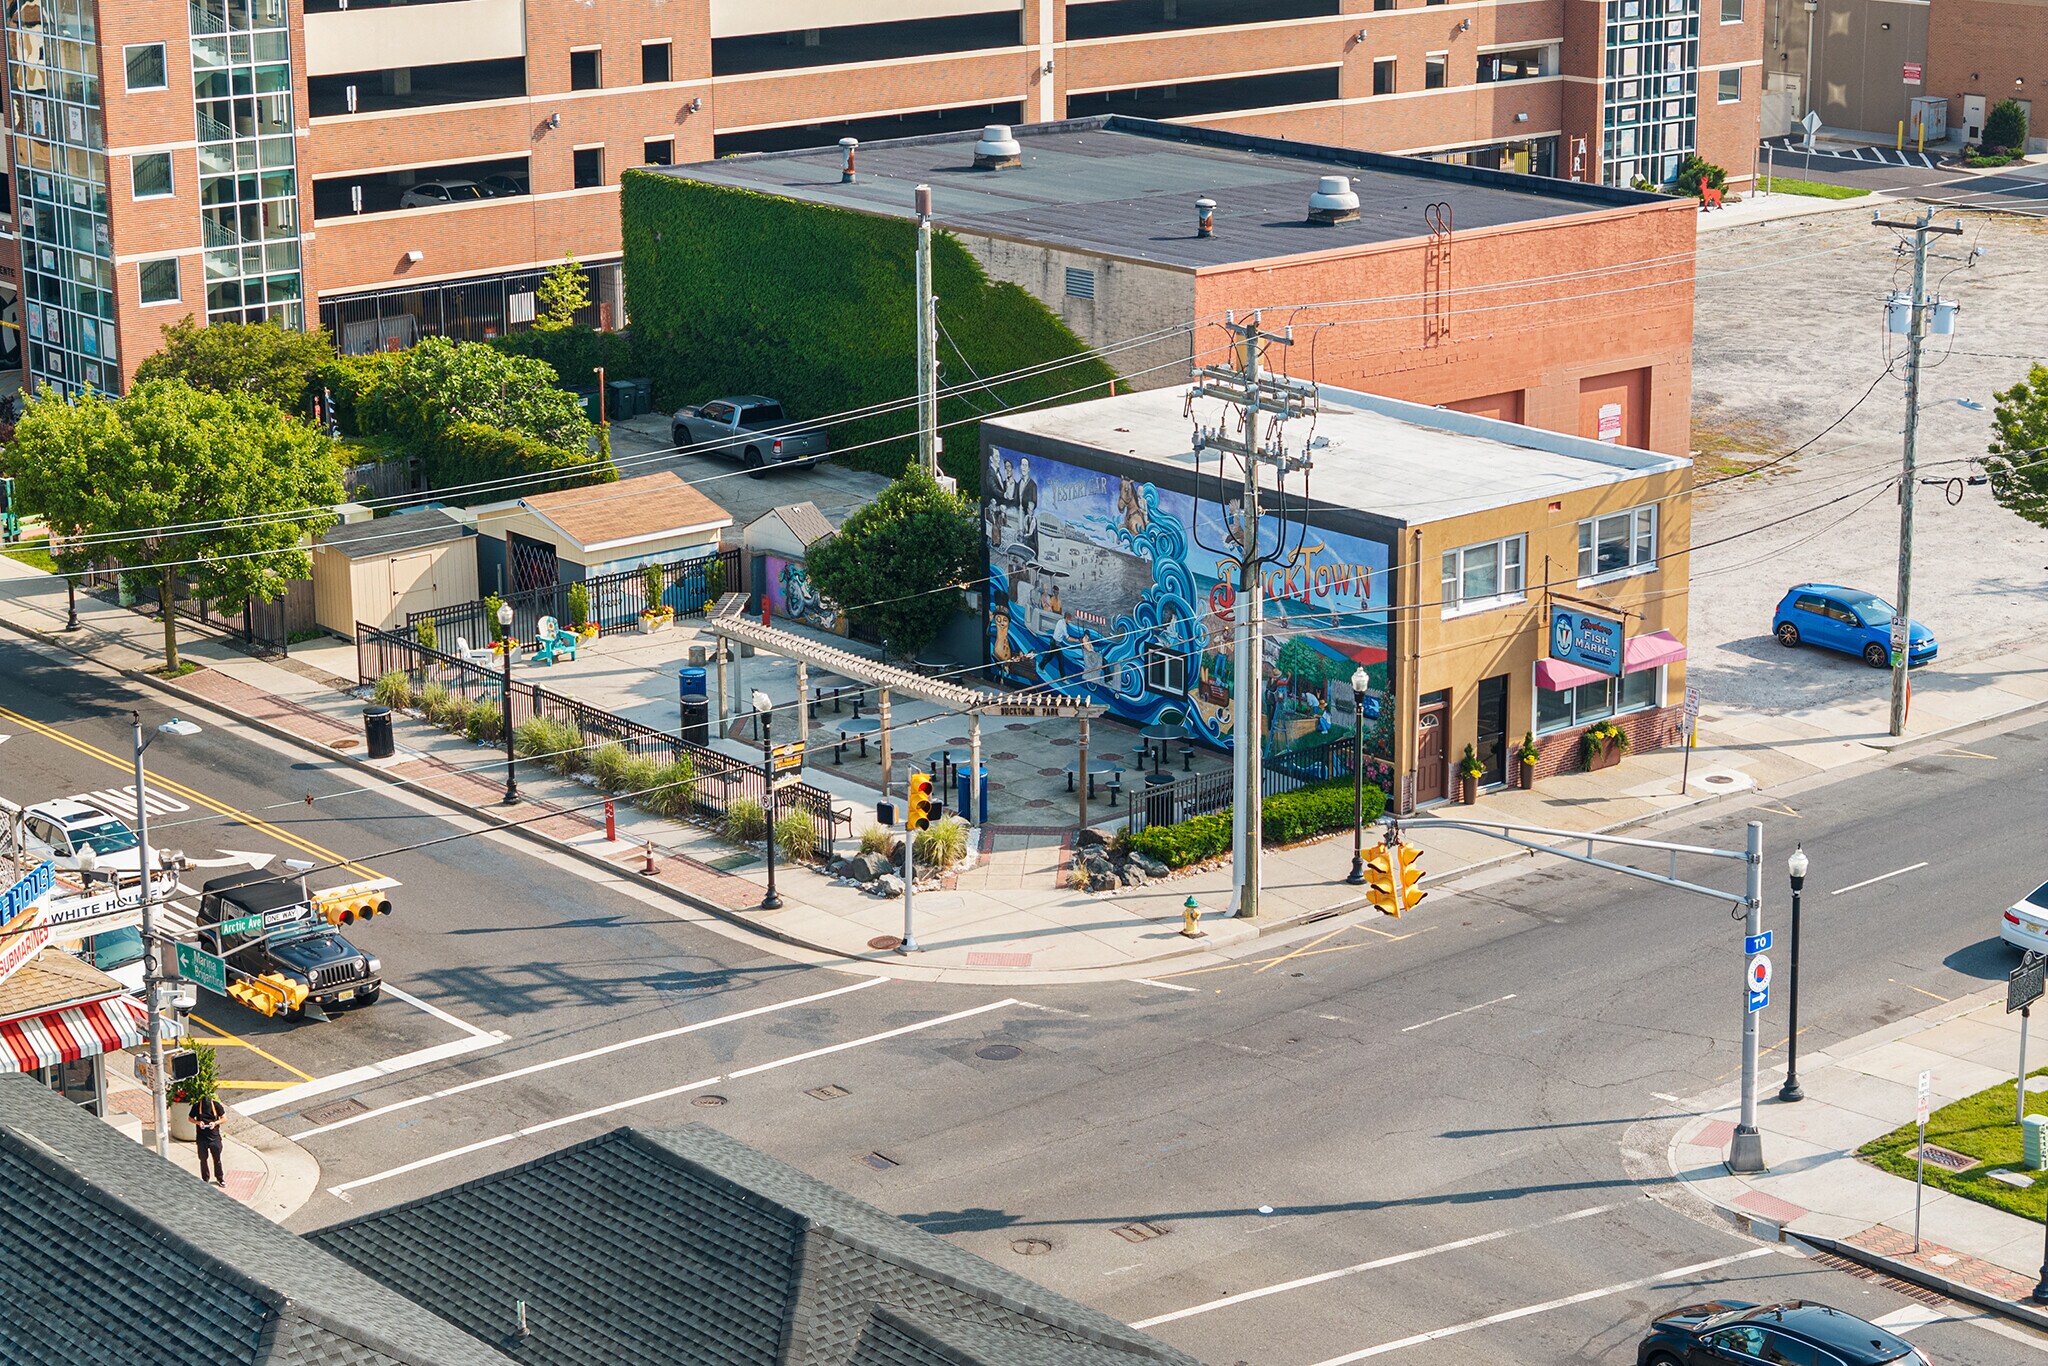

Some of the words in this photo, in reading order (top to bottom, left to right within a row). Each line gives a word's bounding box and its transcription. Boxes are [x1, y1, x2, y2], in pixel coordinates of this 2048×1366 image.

[1048, 476, 1108, 510] YESTERYEAR
[1575, 637, 1618, 657] MARKET
[1584, 630, 1609, 646] FISH
[1042, 708, 1059, 717] PARK
[66, 785, 190, 821] ONL
[11, 860, 56, 918] HOUSE
[51, 903, 100, 923] WHITE
[106, 889, 158, 911] HOUE
[266, 914, 281, 923] ONE
[282, 910, 296, 919] WAY
[223, 921, 246, 934] Arctic
[248, 918, 262, 929] Ave
[0, 917, 49, 977] SUBMARINES
[1753, 936, 1767, 950] TO
[193, 950, 217, 971] Marina
[194, 966, 225, 987] Brigantine
